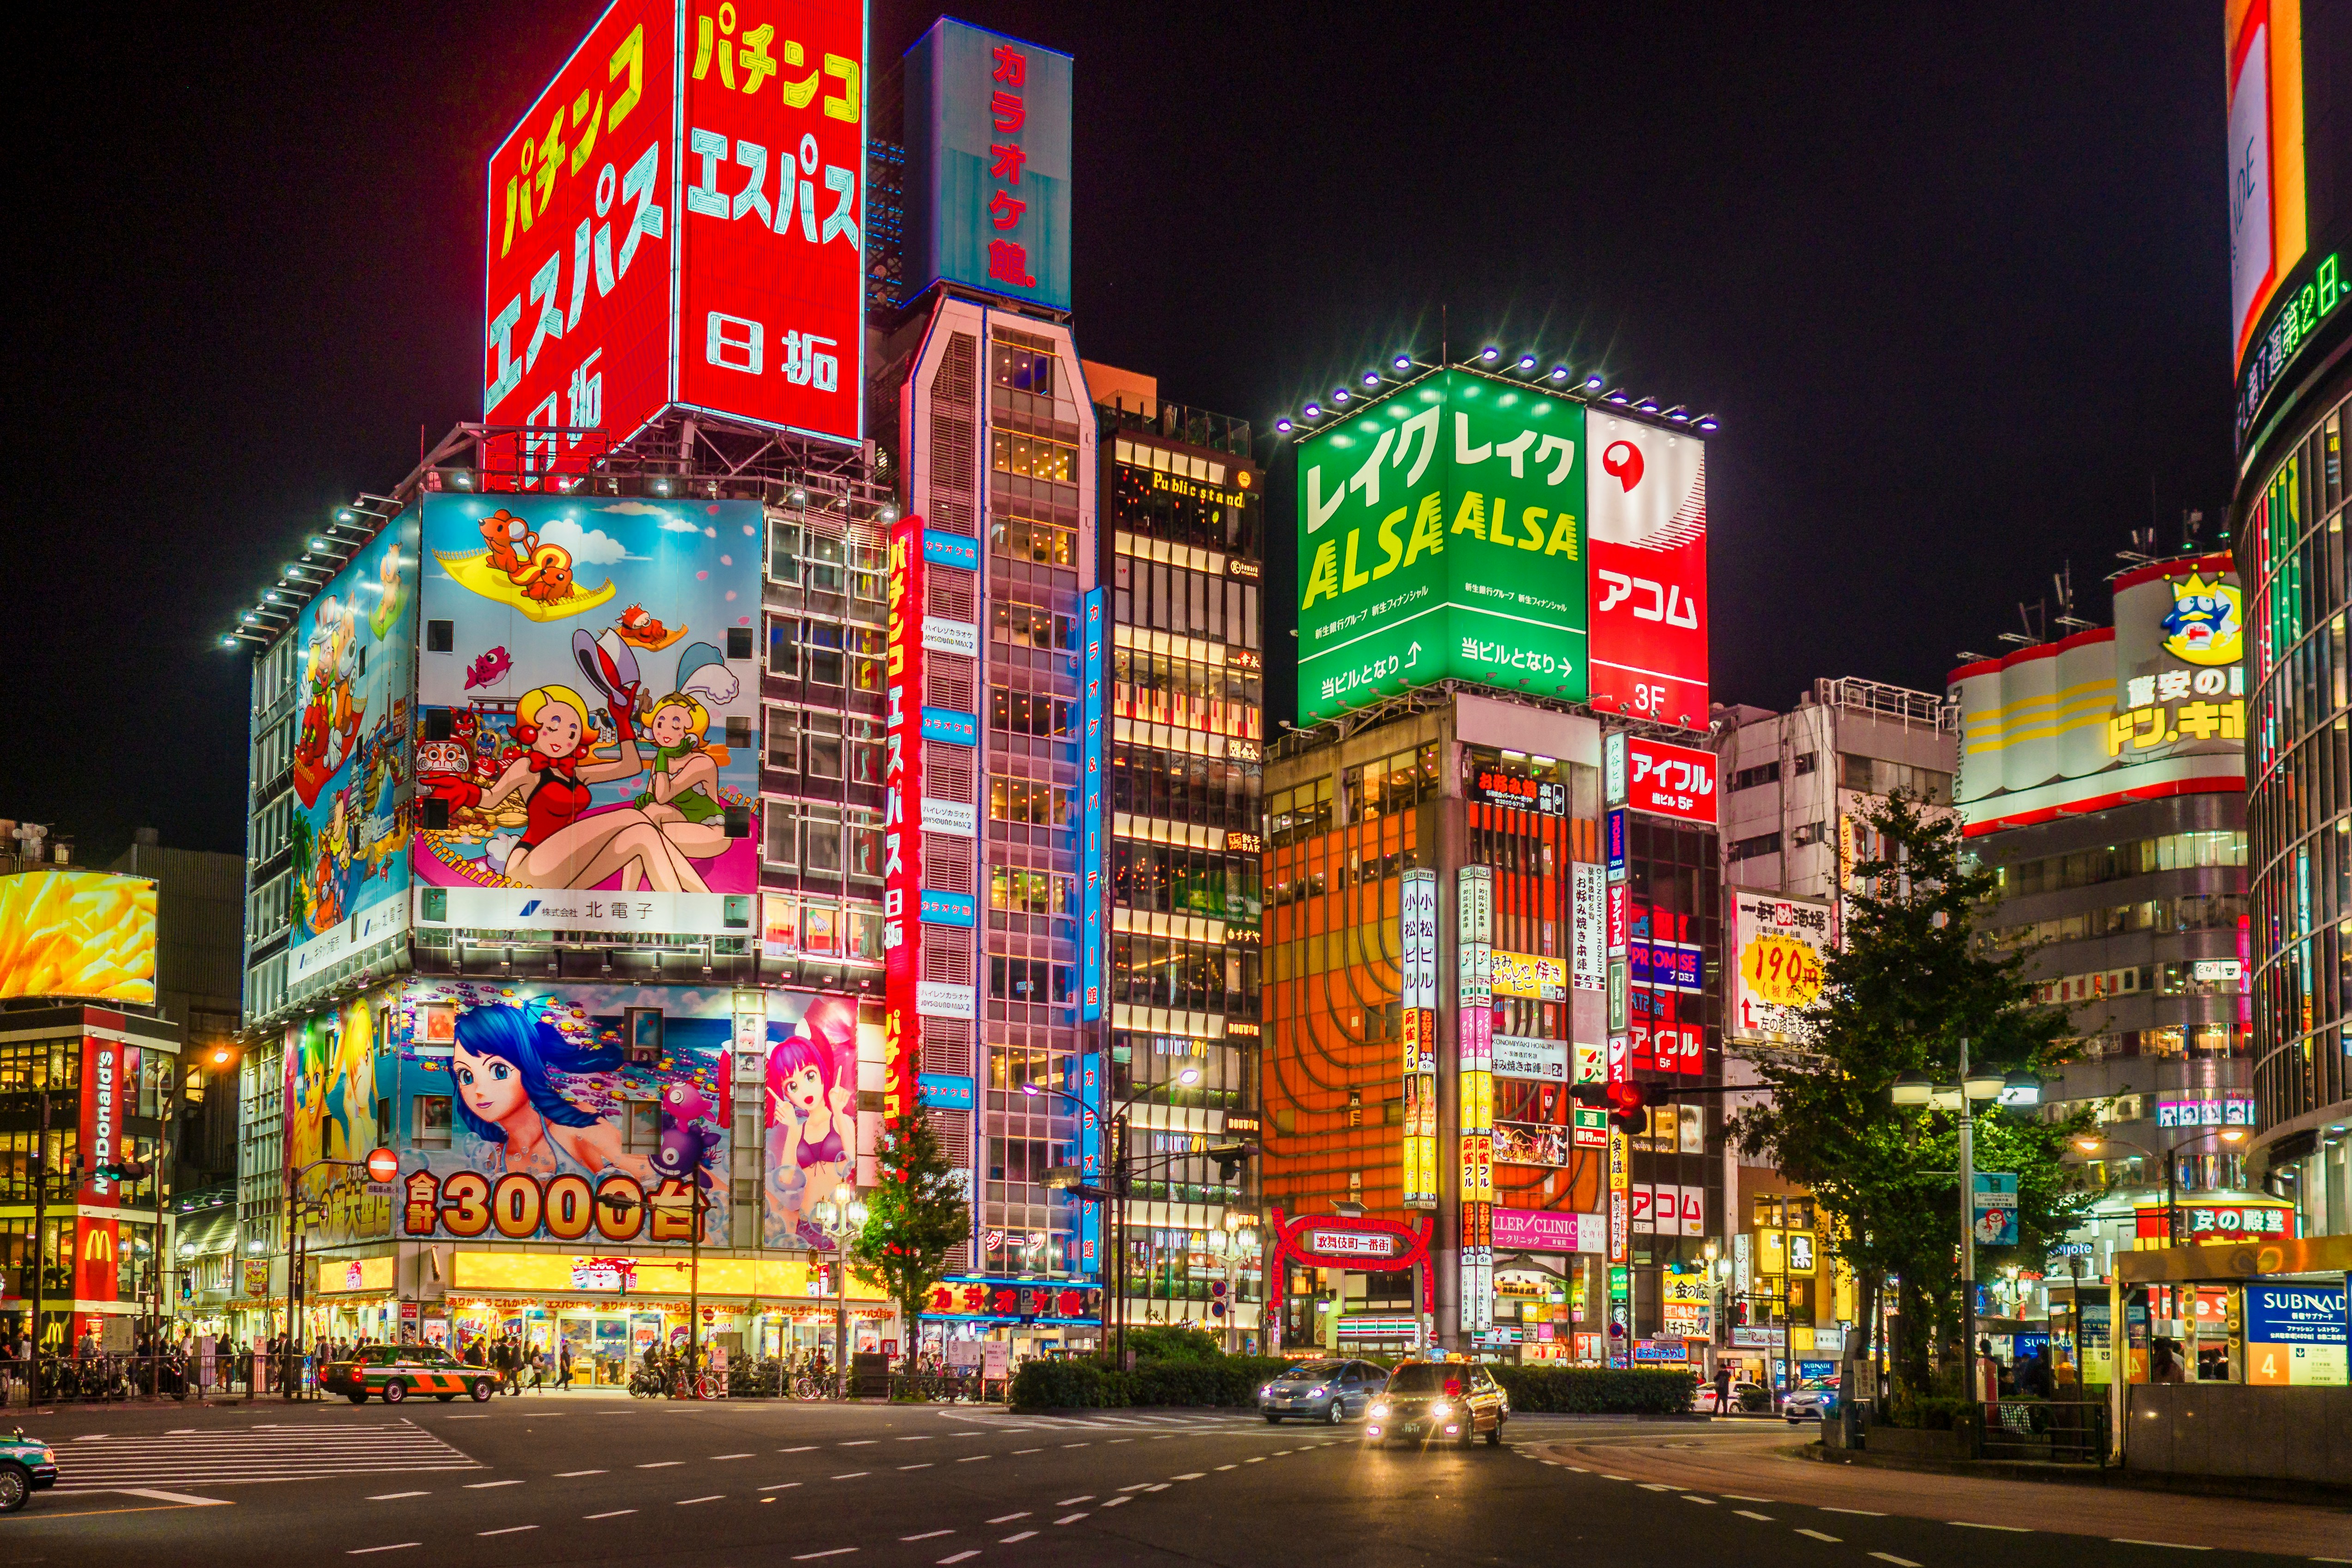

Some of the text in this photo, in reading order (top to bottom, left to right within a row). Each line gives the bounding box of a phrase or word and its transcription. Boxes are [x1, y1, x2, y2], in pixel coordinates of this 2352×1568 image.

[692, 1, 859, 123] パチンコ
[502, 23, 643, 259] パチンコ
[687, 127, 858, 251] エスパス
[486, 140, 663, 414] エスパス
[1455, 411, 1575, 486] レイク
[1307, 405, 1440, 534] レイク
[1154, 471, 1245, 508] Public stand
[1451, 491, 1578, 562] ALSA
[925, 540, 974, 559] カラオケ館
[1301, 490, 1444, 611] ALSA
[889, 536, 907, 677] パチンコ
[1465, 581, 1567, 613] 新生銀行グループ 新生フィナンシャル
[1598, 568, 1699, 630] アコム
[1315, 585, 1429, 640] 新生銀行グループ 新生フィナンシャル
[925, 624, 973, 638] ハイレゾカラオケ
[925, 634, 954, 645] JOYSOUND
[1461, 637, 1556, 674] 当ビルとなり
[1321, 654, 1399, 701] 当ビルとなり
[1634, 683, 1665, 710] 3F
[924, 719, 973, 735] カラオケ館
[1609, 740, 1621, 794] 戸谷ビル
[1631, 752, 1713, 796] アイフル
[886, 685, 904, 878] エスパス
[924, 805, 971, 819] ハイレゾカラオケ
[1554, 795, 1562, 805] 8F
[1652, 792, 1693, 811] 当ビル 5F
[923, 816, 953, 826] JOYSOUND
[1242, 843, 1260, 853] BAR
[542, 900, 653, 919] 株式会社 北電子
[922, 901, 972, 916] カラオケ館
[1740, 901, 1826, 932] 一軒め酒場
[1576, 876, 1587, 970] お好み焼き本陣
[1612, 899, 1623, 945] アイフル
[1405, 893, 1416, 989] 小松ビル
[1420, 893, 1433, 989] 小松ビル
[1536, 961, 1561, 981] 焼き
[1632, 947, 1696, 972] PROMISE
[1755, 944, 1818, 990] 190円
[1512, 976, 1534, 992] たこ
[1669, 970, 1695, 983] プロミス
[921, 989, 970, 1001] ハイレゾカラオケ
[921, 1000, 951, 1009] JOYSOUND
[1228, 1023, 1259, 1036] DOUTOR
[1405, 1011, 1415, 1069] 麻雀ブル
[1631, 1026, 1699, 1058] アイフル
[1531, 1042, 1554, 1051] HONJIN
[884, 1009, 901, 1119] パチンコ
[1552, 1064, 1562, 1077] 2F
[920, 1084, 969, 1099] カラオケ館
[94, 1050, 114, 1195] McDonald's
[1228, 1118, 1259, 1131] DOUTOR
[1584, 1112, 1597, 1126] 酒
[1082, 1069, 1095, 1259] カラオケ館
[1463, 1138, 1474, 1188] 麻雀ブル
[1478, 1138, 1489, 1188] 麻雀ブル
[1611, 1137, 1622, 1174] 金の蔵
[1465, 1190, 1472, 1198] 6F
[1480, 1190, 1488, 1198] 6F
[1614, 1177, 1624, 1187] 2F
[405, 1170, 709, 1241] 合計 3000台
[1632, 1191, 1701, 1220] アコム
[1534, 1218, 1577, 1235] CLINIC
[1581, 1229, 1603, 1238] 皮膚科
[1584, 1218, 1601, 1228] 美容
[1635, 1223, 1646, 1231] 3F
[2193, 1209, 2285, 1233] 安の殿堂
[986, 1230, 1046, 1253] ダーツ
[1316, 1235, 1390, 1252] 歌舞伎町一番街
[2317, 1325, 2340, 1333] レストラン
[2261, 1353, 2277, 1378] 4
